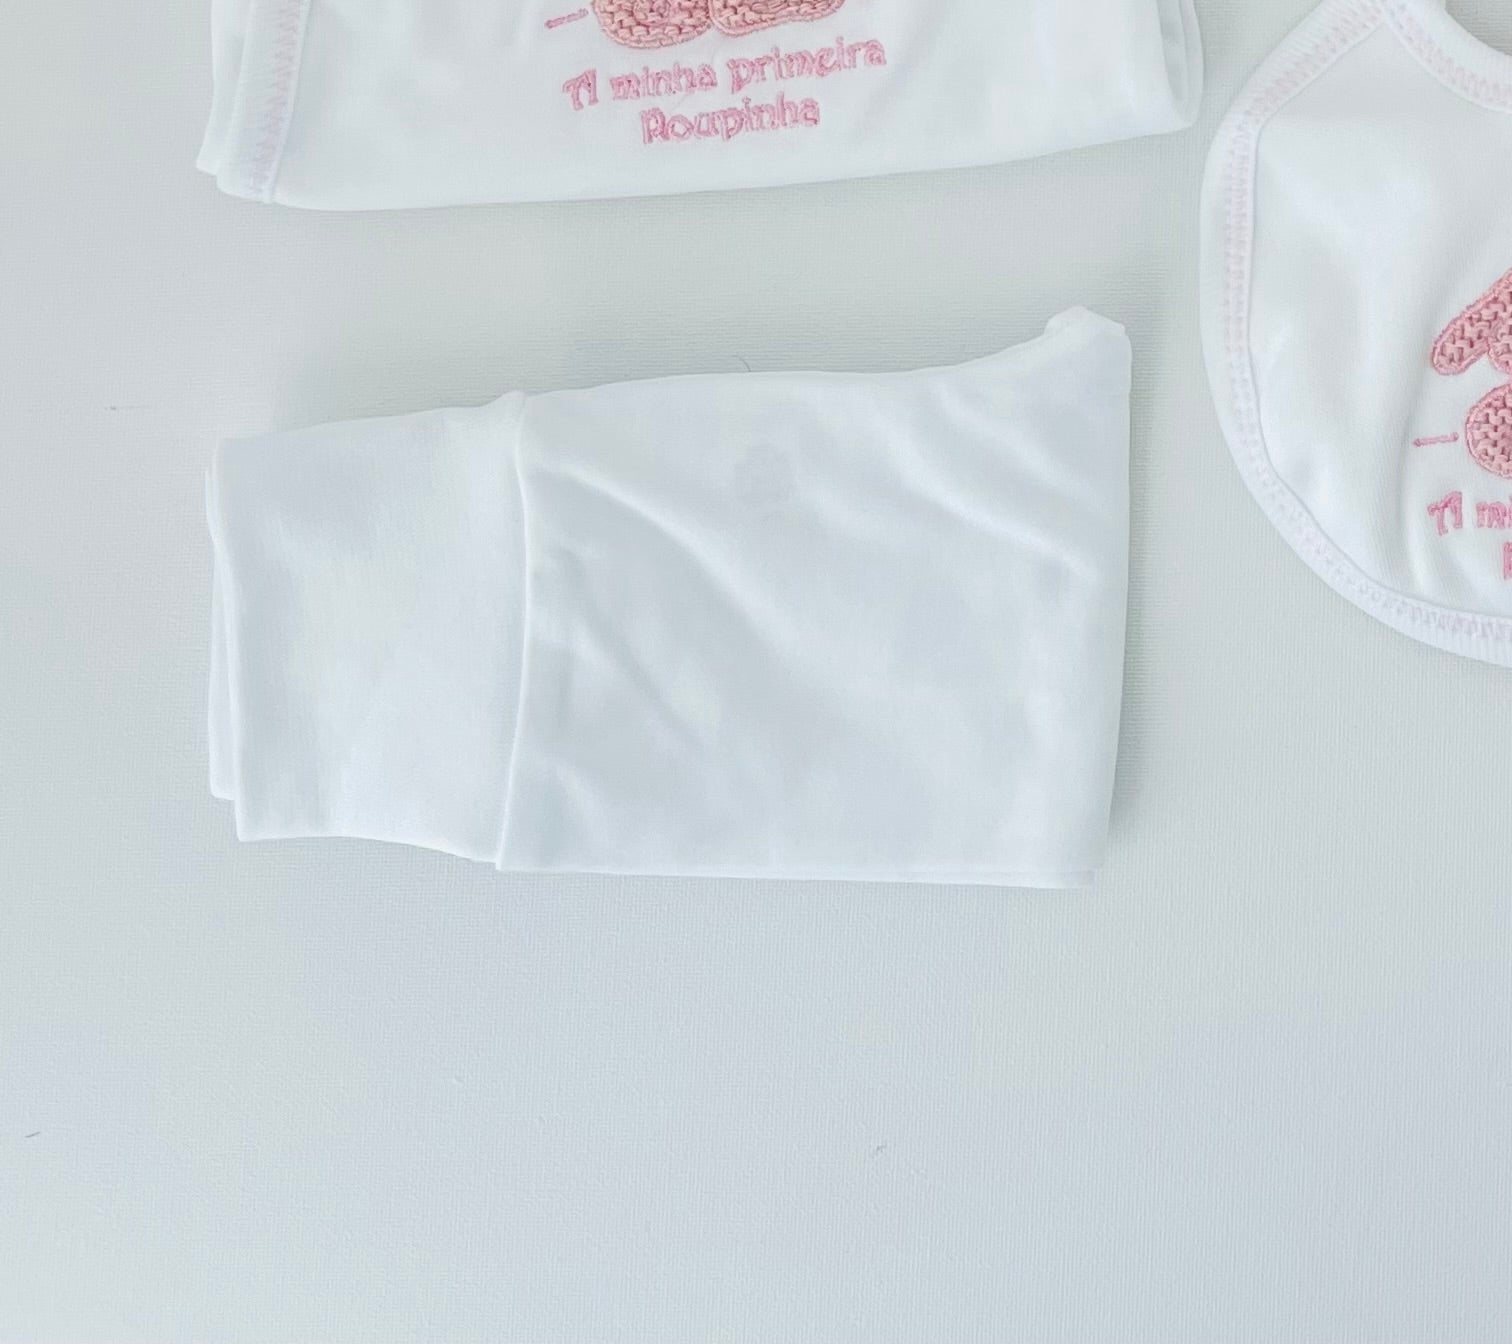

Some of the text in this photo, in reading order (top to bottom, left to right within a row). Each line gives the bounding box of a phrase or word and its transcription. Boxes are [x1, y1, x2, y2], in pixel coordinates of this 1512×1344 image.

[562, 36, 888, 111] A minha primeira
[641, 91, 822, 145] Roupinha
[1427, 490, 1464, 537] A
